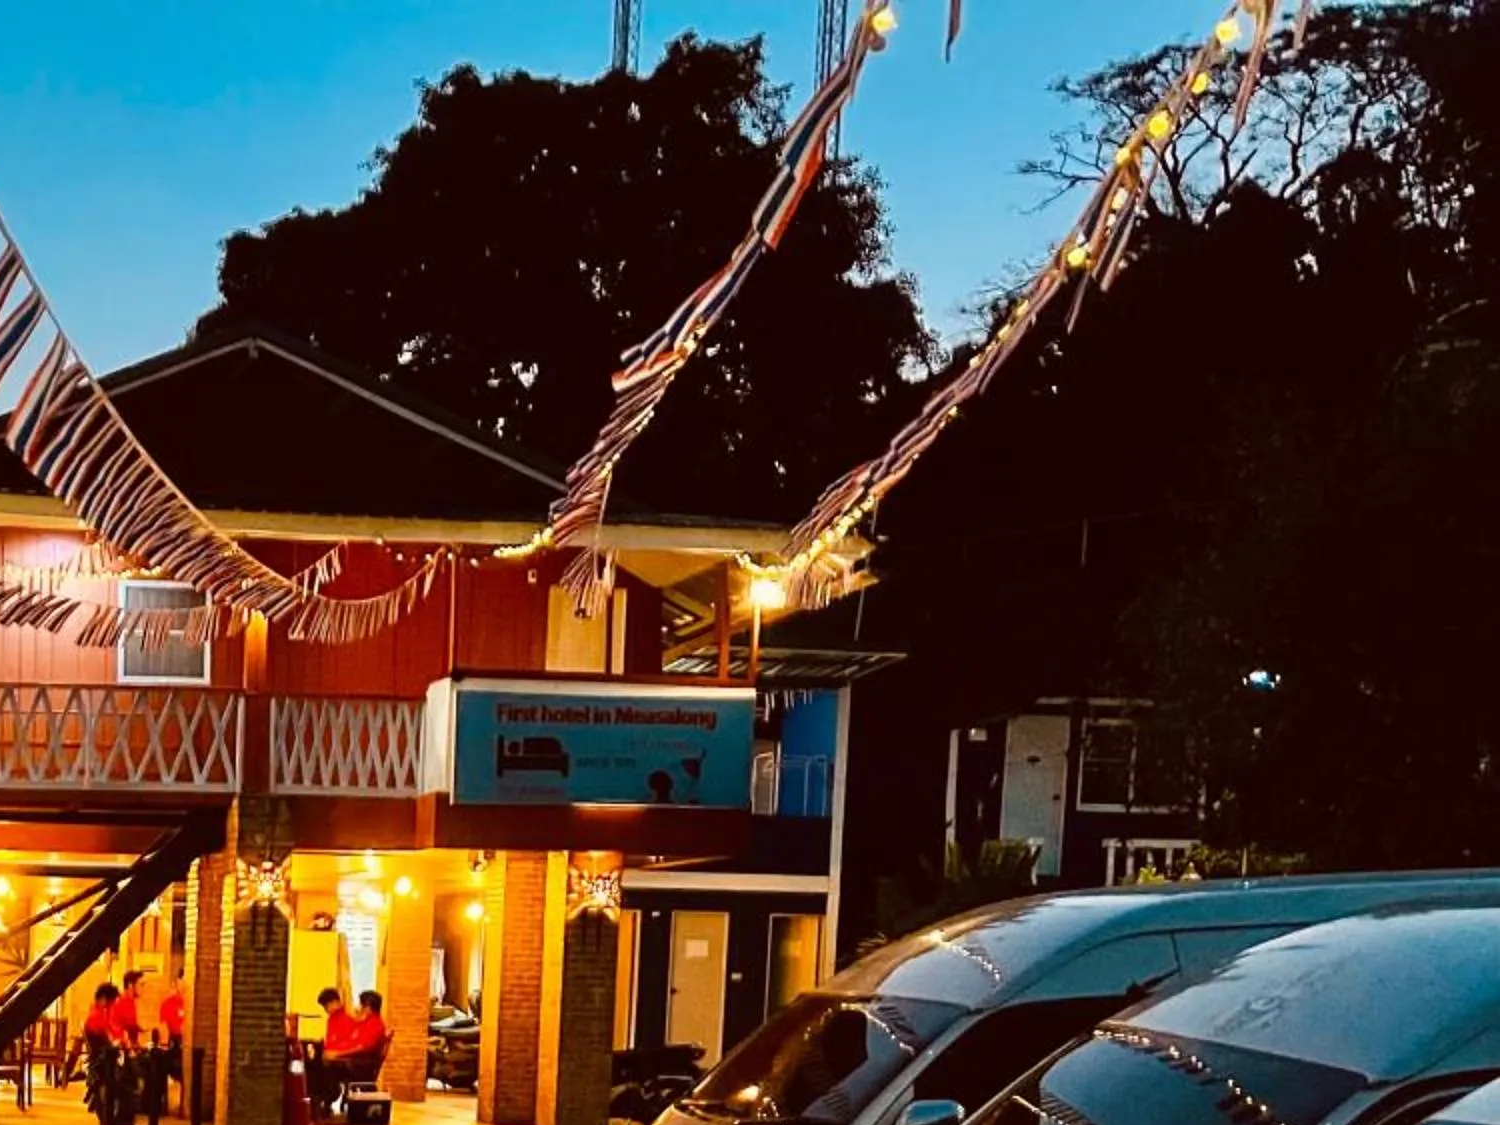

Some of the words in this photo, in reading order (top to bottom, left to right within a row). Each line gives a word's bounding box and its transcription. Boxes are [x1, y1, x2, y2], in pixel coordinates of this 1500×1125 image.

[496, 703, 536, 724] First
[541, 704, 590, 725] hotel
[593, 705, 611, 726] in
